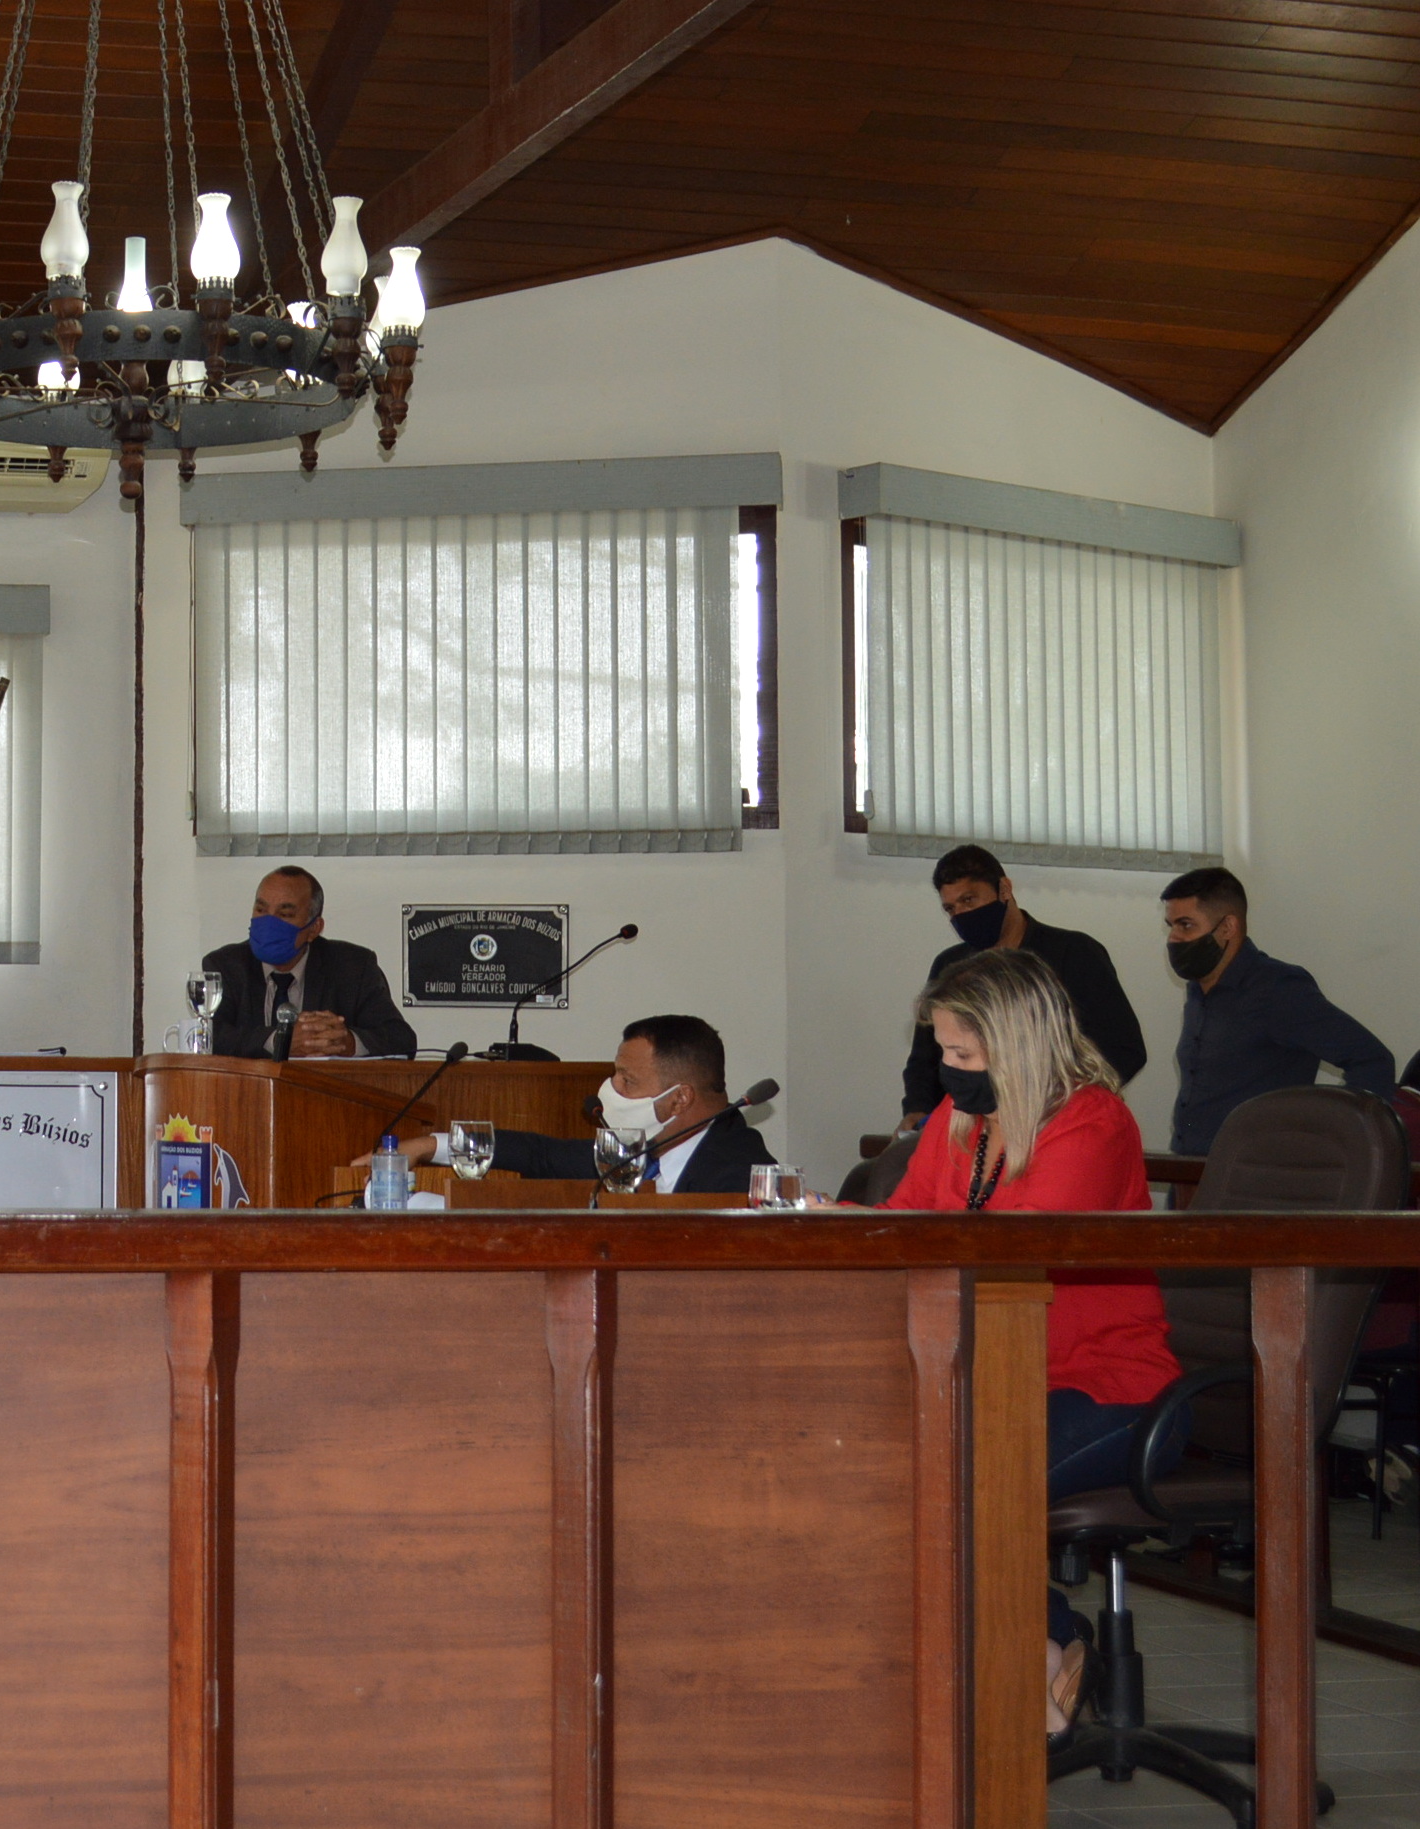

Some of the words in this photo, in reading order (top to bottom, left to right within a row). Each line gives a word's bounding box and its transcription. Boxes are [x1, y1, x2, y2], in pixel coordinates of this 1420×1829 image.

[438, 911, 476, 929] MUNICIPAL
[477, 911, 486, 922] DE
[487, 911, 521, 926] ARMAÇÃO
[521, 916, 537, 930] DOS
[536, 921, 561, 941] BÚZIOS
[462, 963, 505, 972] PLENÁRIO
[461, 972, 506, 981] VEREADOR
[425, 981, 456, 994] EMÍGDIO
[461, 982, 504, 994] GONÇALVES
[20, 1113, 93, 1148] Búzios
